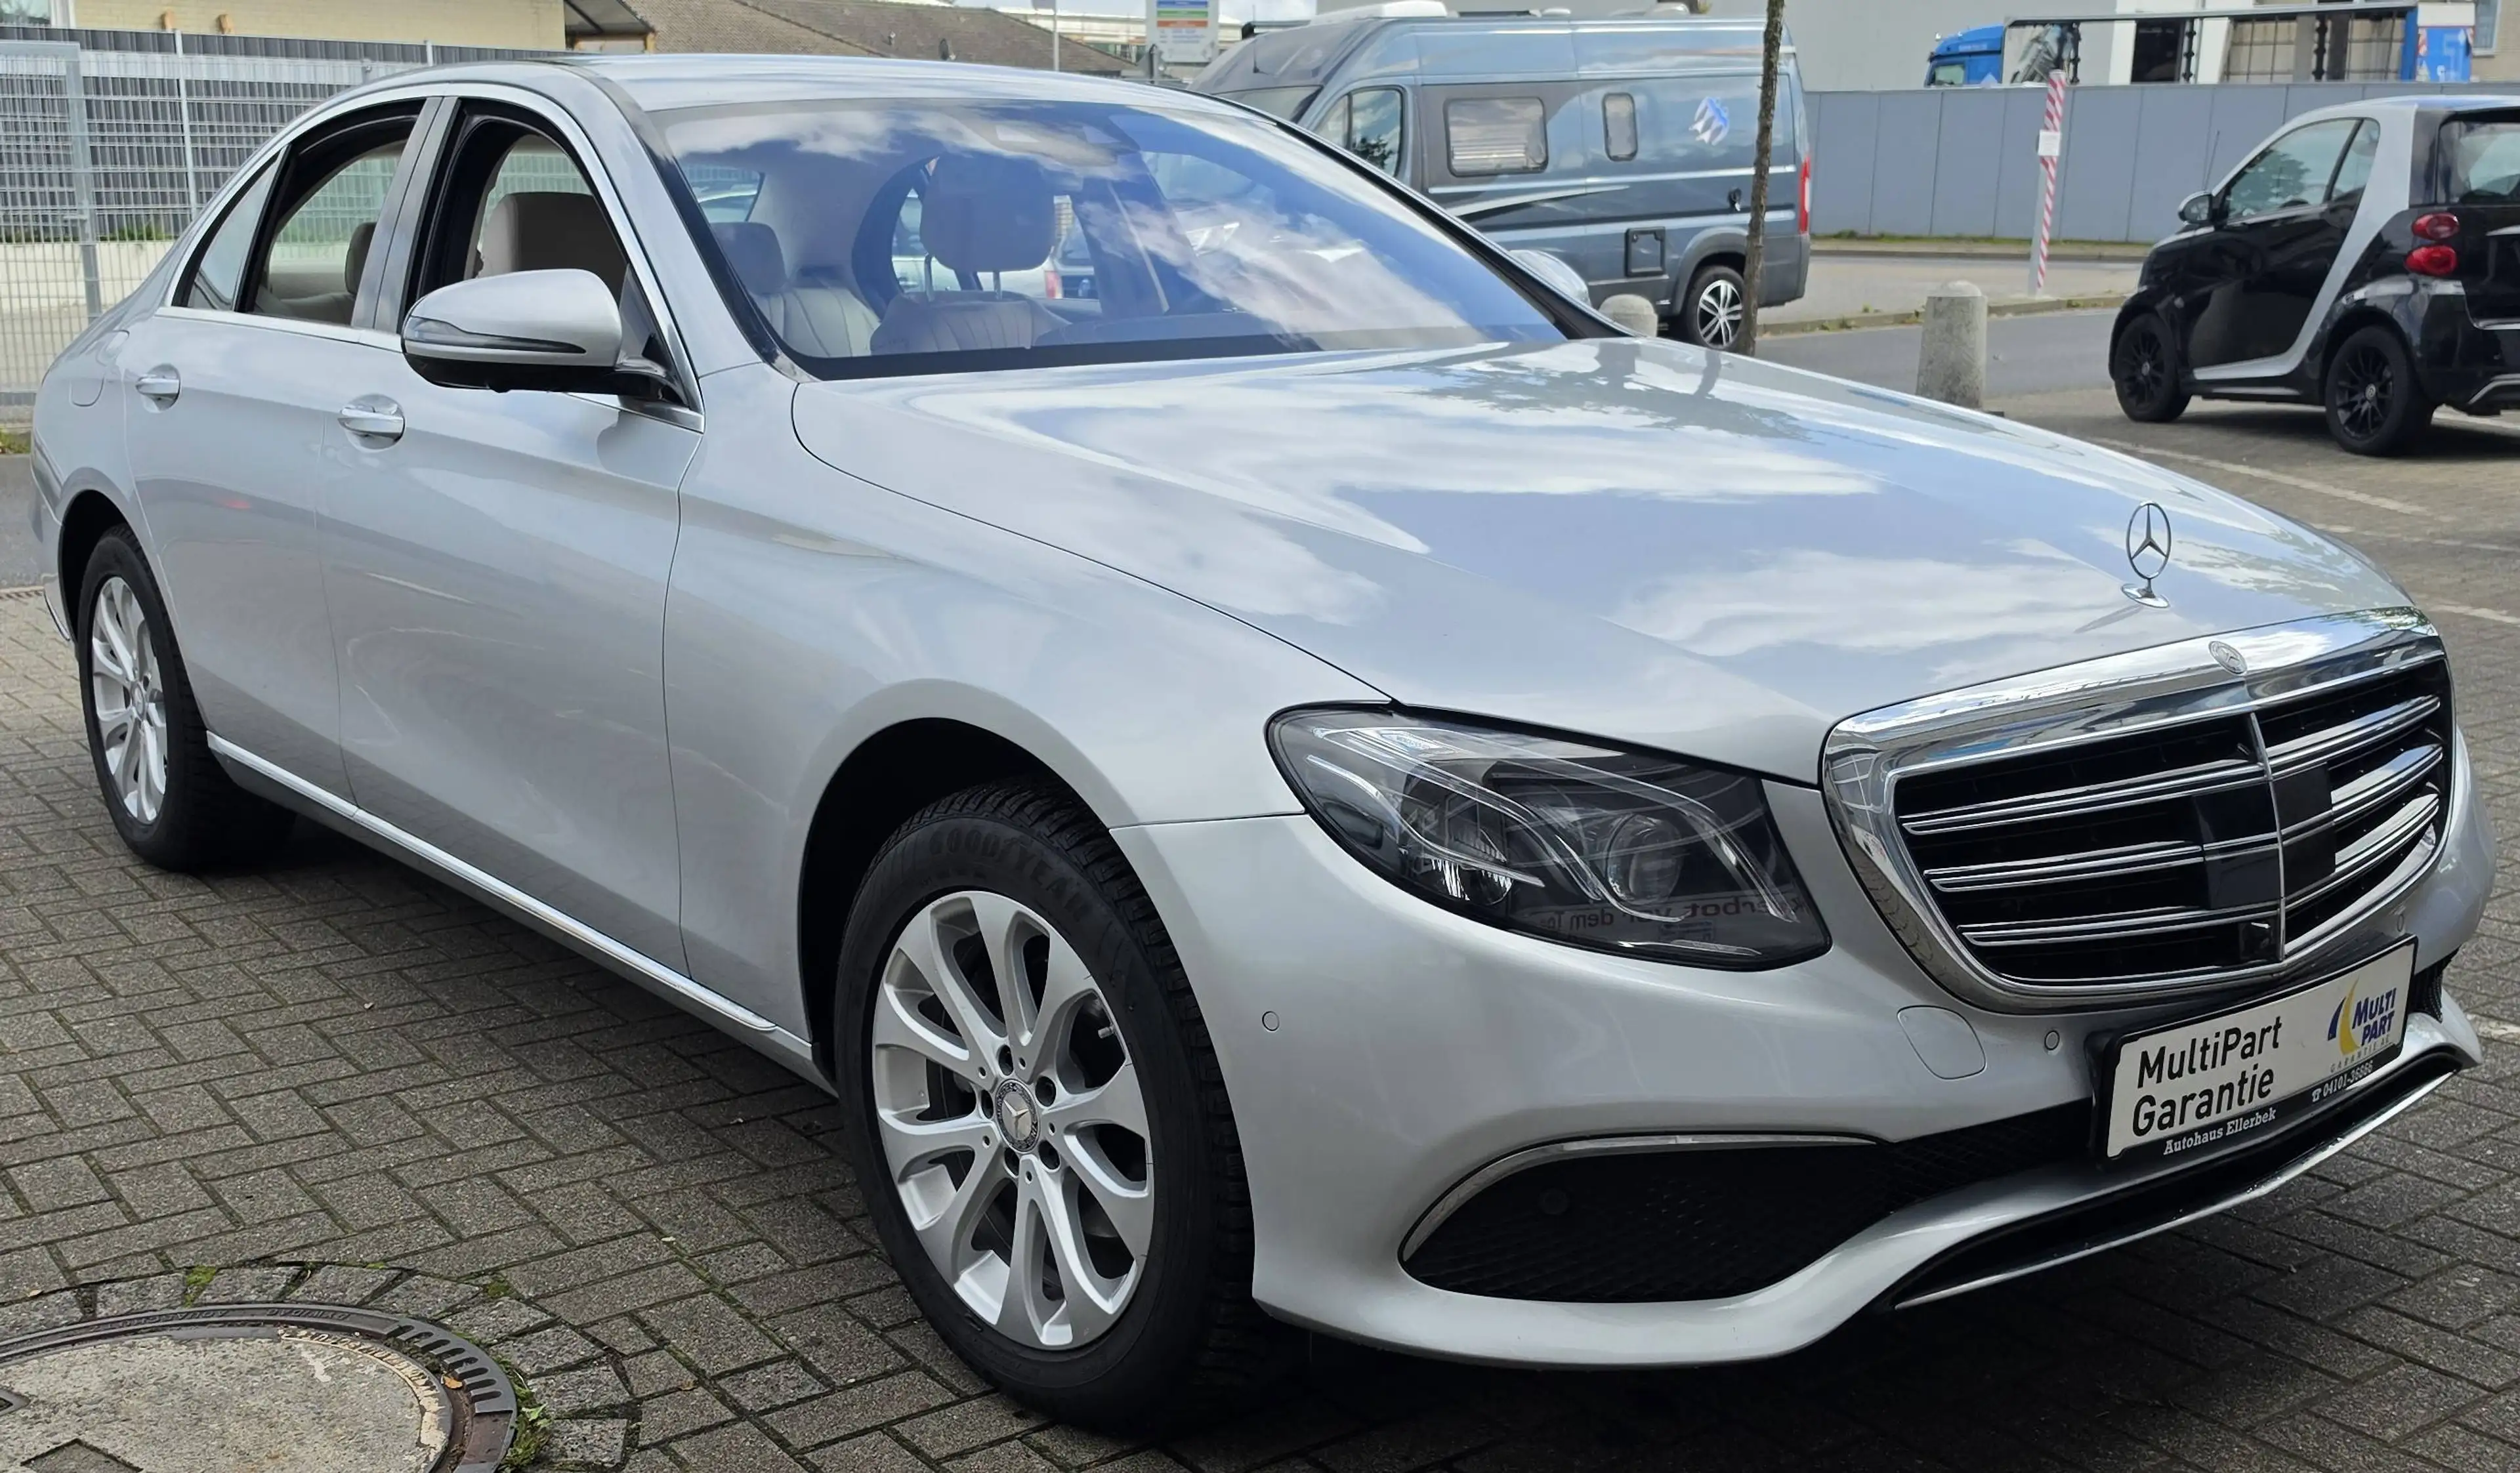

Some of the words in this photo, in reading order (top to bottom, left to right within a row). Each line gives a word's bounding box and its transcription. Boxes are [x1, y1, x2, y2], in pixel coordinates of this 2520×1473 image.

[929, 828, 1093, 923] GOODYEAR
[2351, 987, 2397, 1029] MULTI
[2361, 1010, 2395, 1046] PART
[2137, 1016, 2282, 1089] MultiPart
[2132, 1063, 2274, 1137] Garantie
[2163, 1127, 2223, 1155] Autohaus
[2225, 1107, 2277, 1136] Ellerbek
